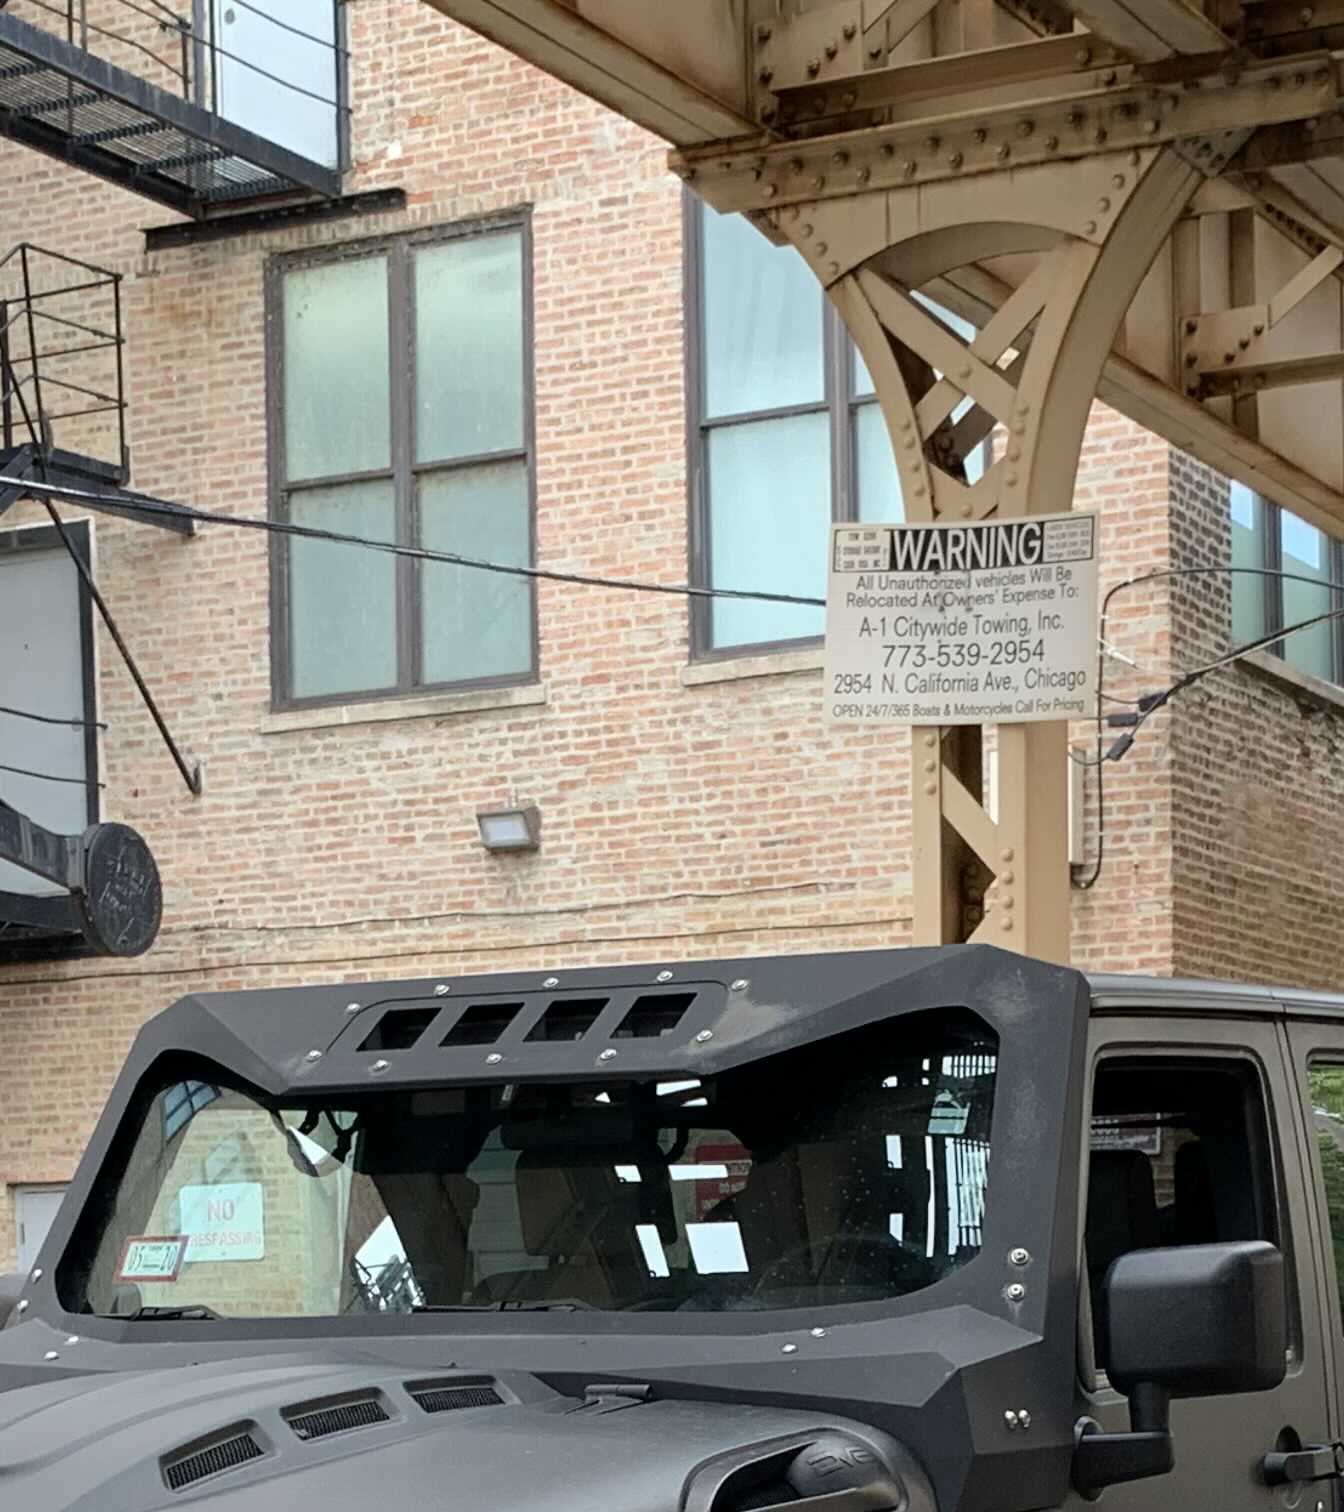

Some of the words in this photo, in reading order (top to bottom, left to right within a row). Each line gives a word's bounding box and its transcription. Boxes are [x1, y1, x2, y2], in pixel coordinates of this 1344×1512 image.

[893, 522, 1041, 572] WARNING
[856, 576, 874, 590] All
[878, 571, 972, 591] Unauthorized
[976, 570, 1026, 588] vehicles
[1030, 566, 1053, 583] Will
[1056, 566, 1072, 581] Be
[846, 592, 918, 608] Relocated
[1002, 588, 1055, 606] Expense
[1059, 582, 1079, 599] To:
[858, 616, 887, 637] A-1
[894, 615, 968, 641] Citywide
[973, 612, 1032, 638] Towing,
[1038, 608, 1065, 631] Inc.
[882, 638, 1045, 668] 773-539-2954
[834, 673, 872, 694] 2954
[881, 672, 899, 694] N.
[904, 670, 979, 694] California
[1024, 667, 1086, 691] Chicago
[832, 704, 863, 718] OPEN
[865, 703, 911, 718] 24/7/365
[954, 702, 1013, 716] Motorcycles
[1016, 700, 1034, 714] Call
[1036, 699, 1051, 712] For
[1053, 697, 1084, 713] Pricing
[207, 1198, 235, 1222] NO
